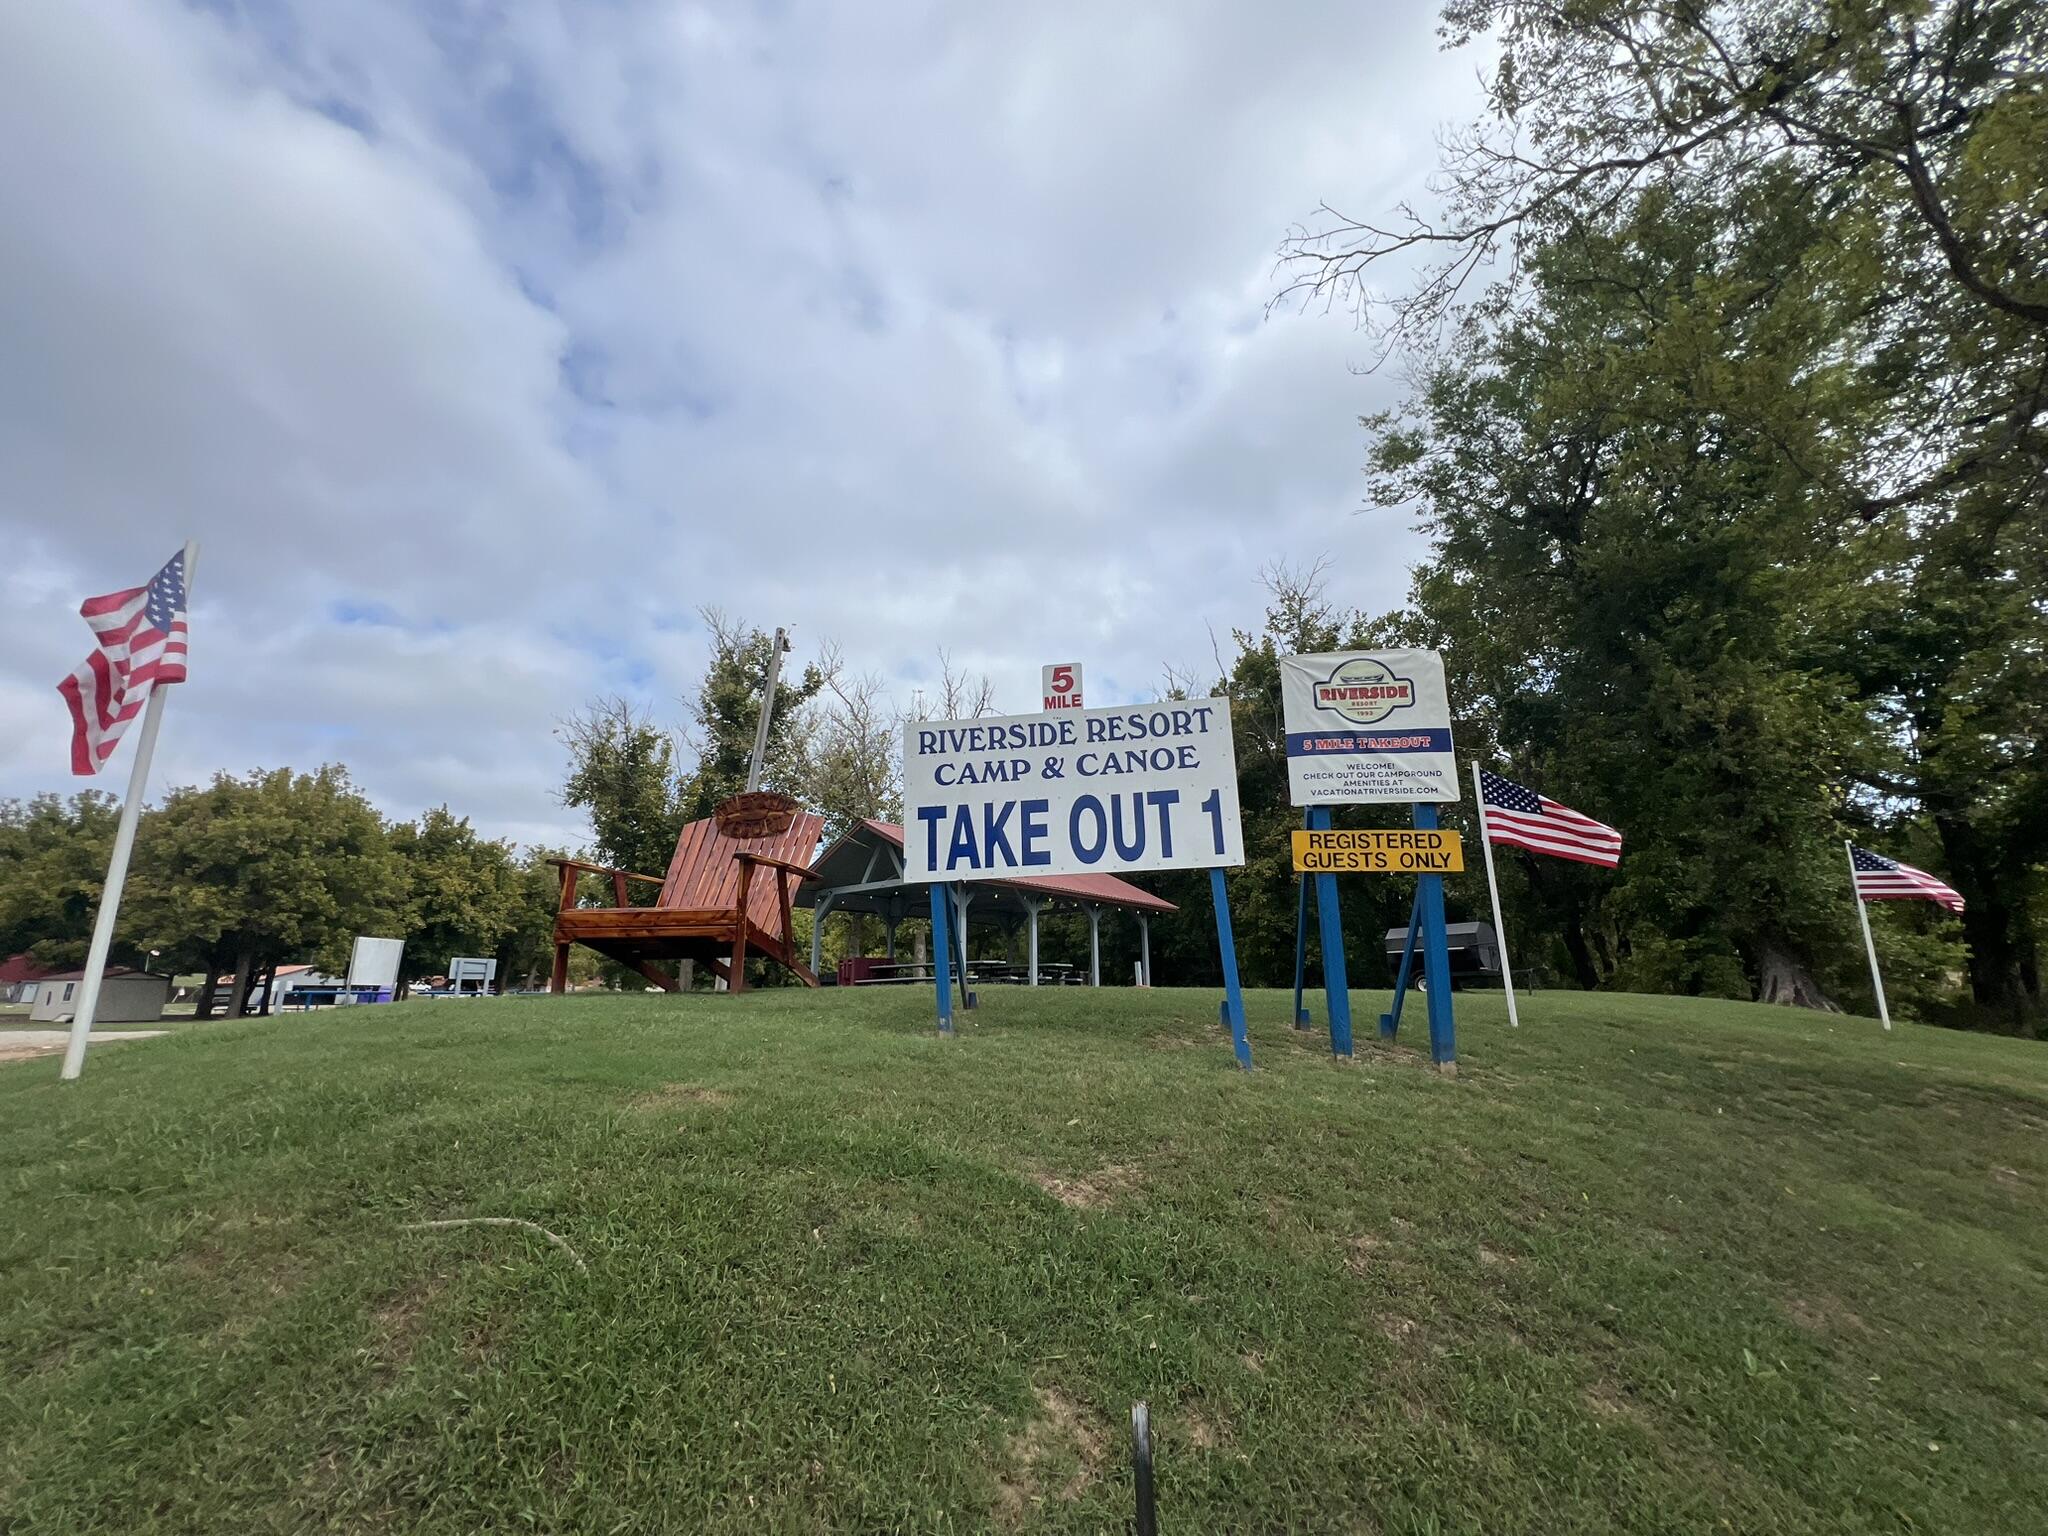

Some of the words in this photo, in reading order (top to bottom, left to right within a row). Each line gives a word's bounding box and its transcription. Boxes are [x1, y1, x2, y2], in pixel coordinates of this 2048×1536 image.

[1051, 666, 1074, 693] 5
[1319, 685, 1409, 701] RIVERSIDE
[1044, 694, 1082, 710] MILE
[918, 719, 1078, 755] RIVERSIDE
[1086, 707, 1213, 743] RESORT
[1303, 740, 1312, 750] 5
[1315, 738, 1354, 750] MILE
[1357, 736, 1431, 749] TAKEOUT
[934, 759, 1031, 786] CAMP
[1041, 756, 1065, 780] &
[1076, 745, 1201, 777] CANOE
[1356, 771, 1376, 779] OUR
[1377, 770, 1442, 778] CAMPGROUND
[1310, 787, 1439, 796] VACATIONATRIVERSIDE.COM
[917, 799, 1052, 872] TAKE
[1069, 789, 1180, 865] OUT
[1201, 788, 1225, 855] 1
[1309, 833, 1443, 849] REGISTERED
[1303, 852, 1387, 868] GUESTS
[1400, 852, 1451, 868] ONLY
